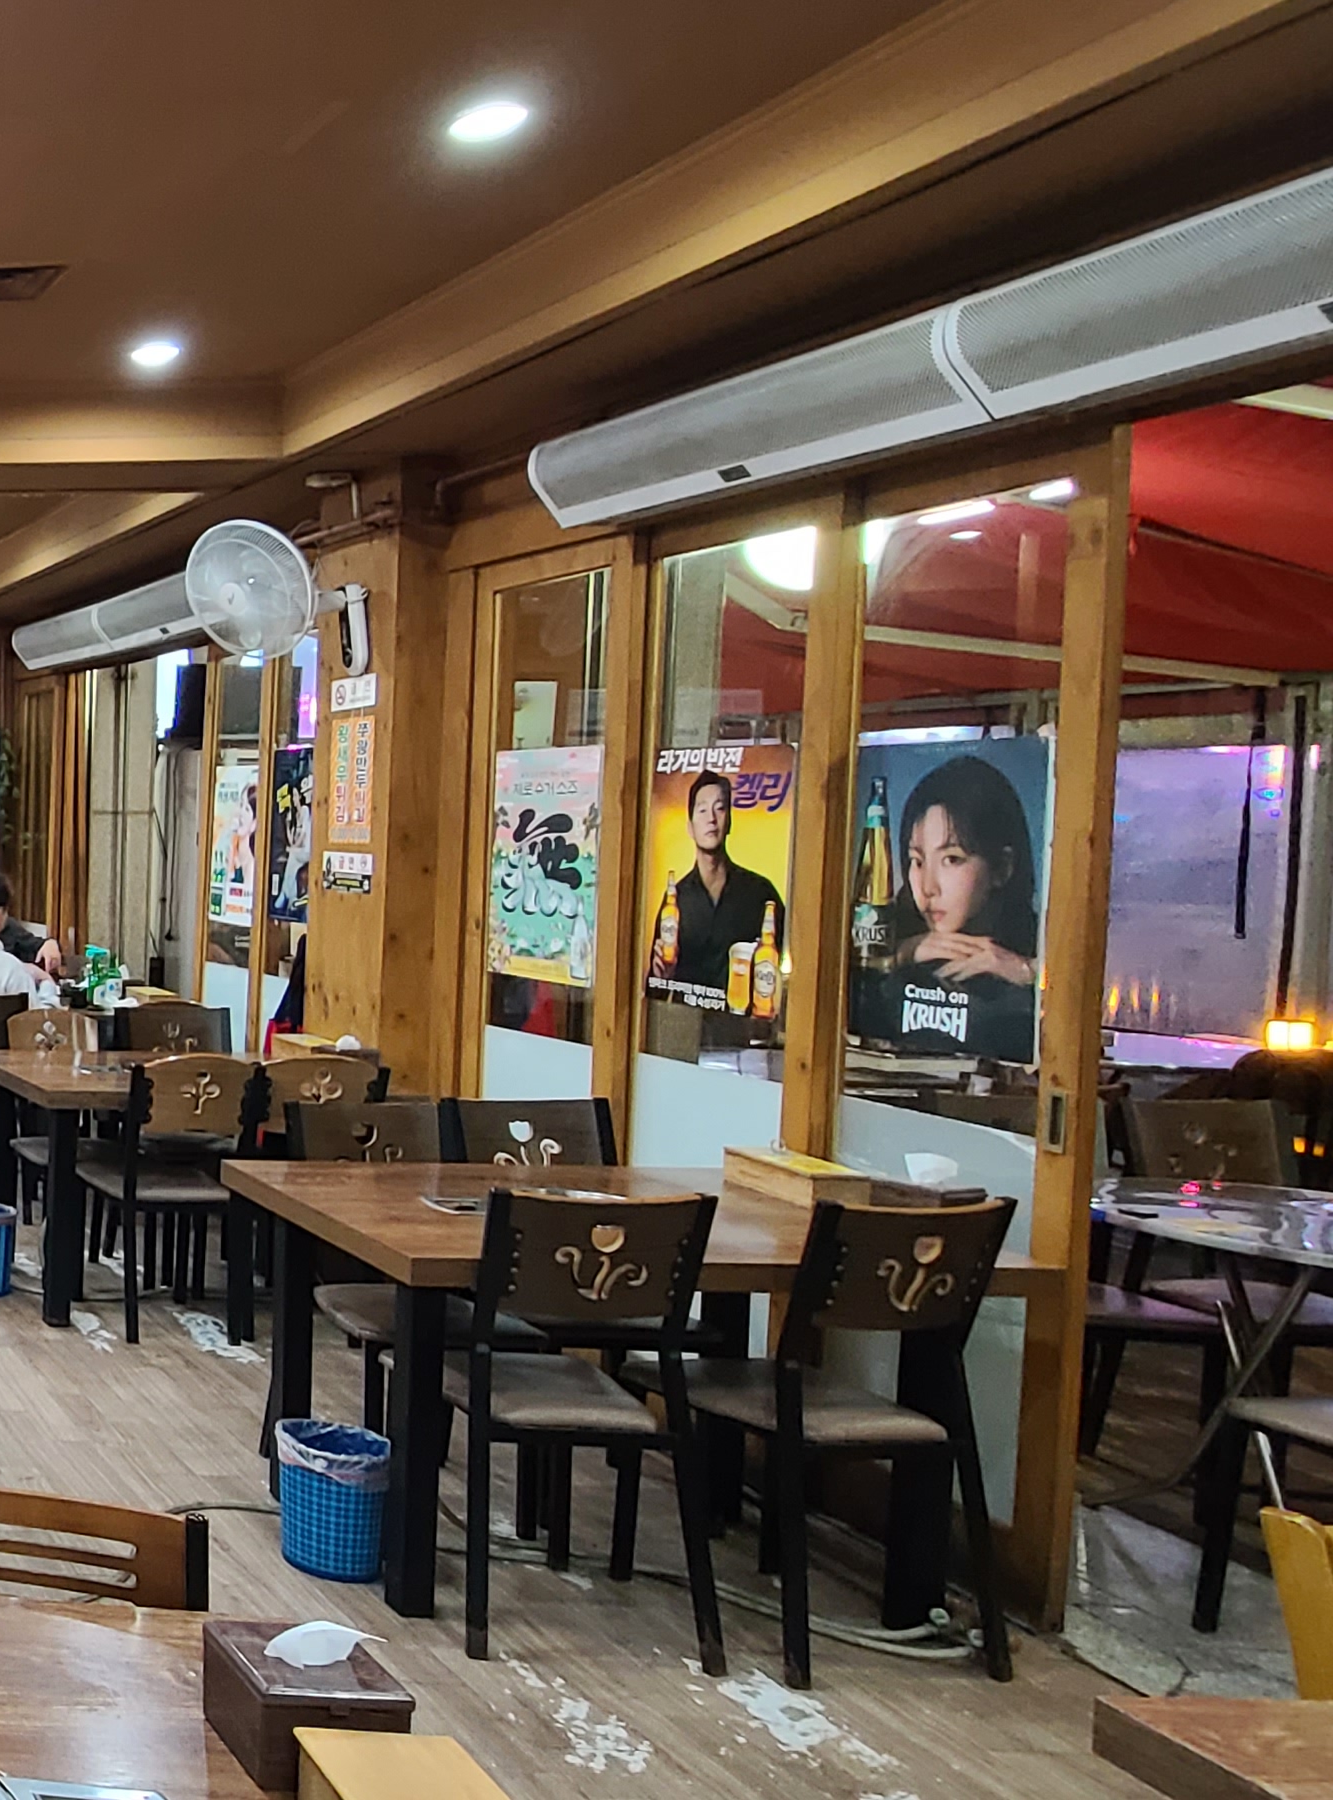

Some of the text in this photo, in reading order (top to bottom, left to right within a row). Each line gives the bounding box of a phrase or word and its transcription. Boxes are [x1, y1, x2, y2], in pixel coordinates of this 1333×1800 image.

[656, 747, 744, 774] 라거의 반전
[732, 772, 792, 812] 켈리
[854, 926, 888, 943] KRUS
[905, 983, 968, 1004] Crush on
[902, 1000, 968, 1043] KRUSH
